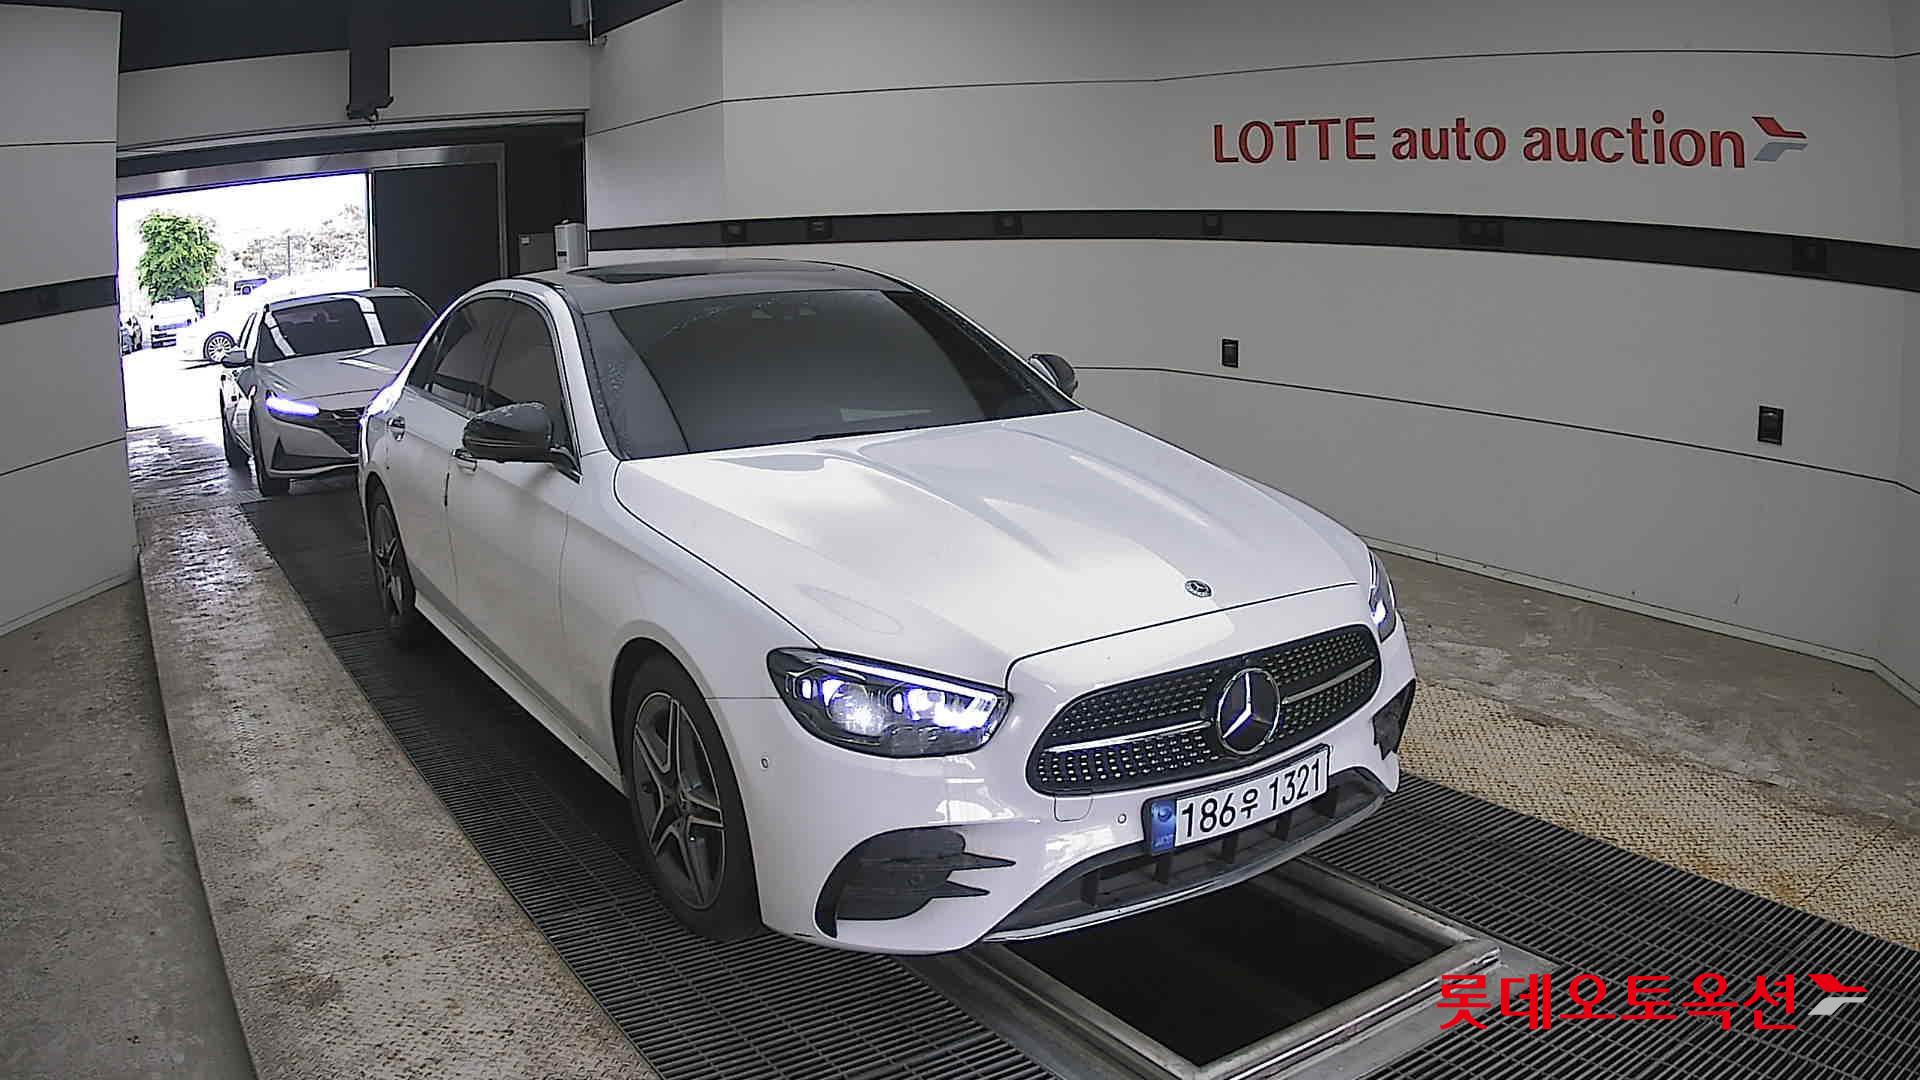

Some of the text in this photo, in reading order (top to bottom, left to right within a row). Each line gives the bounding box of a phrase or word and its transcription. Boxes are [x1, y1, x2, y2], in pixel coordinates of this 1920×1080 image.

[1213, 109, 1746, 169] LOTTE auto auction
[1181, 758, 1320, 838] 186우 1321
